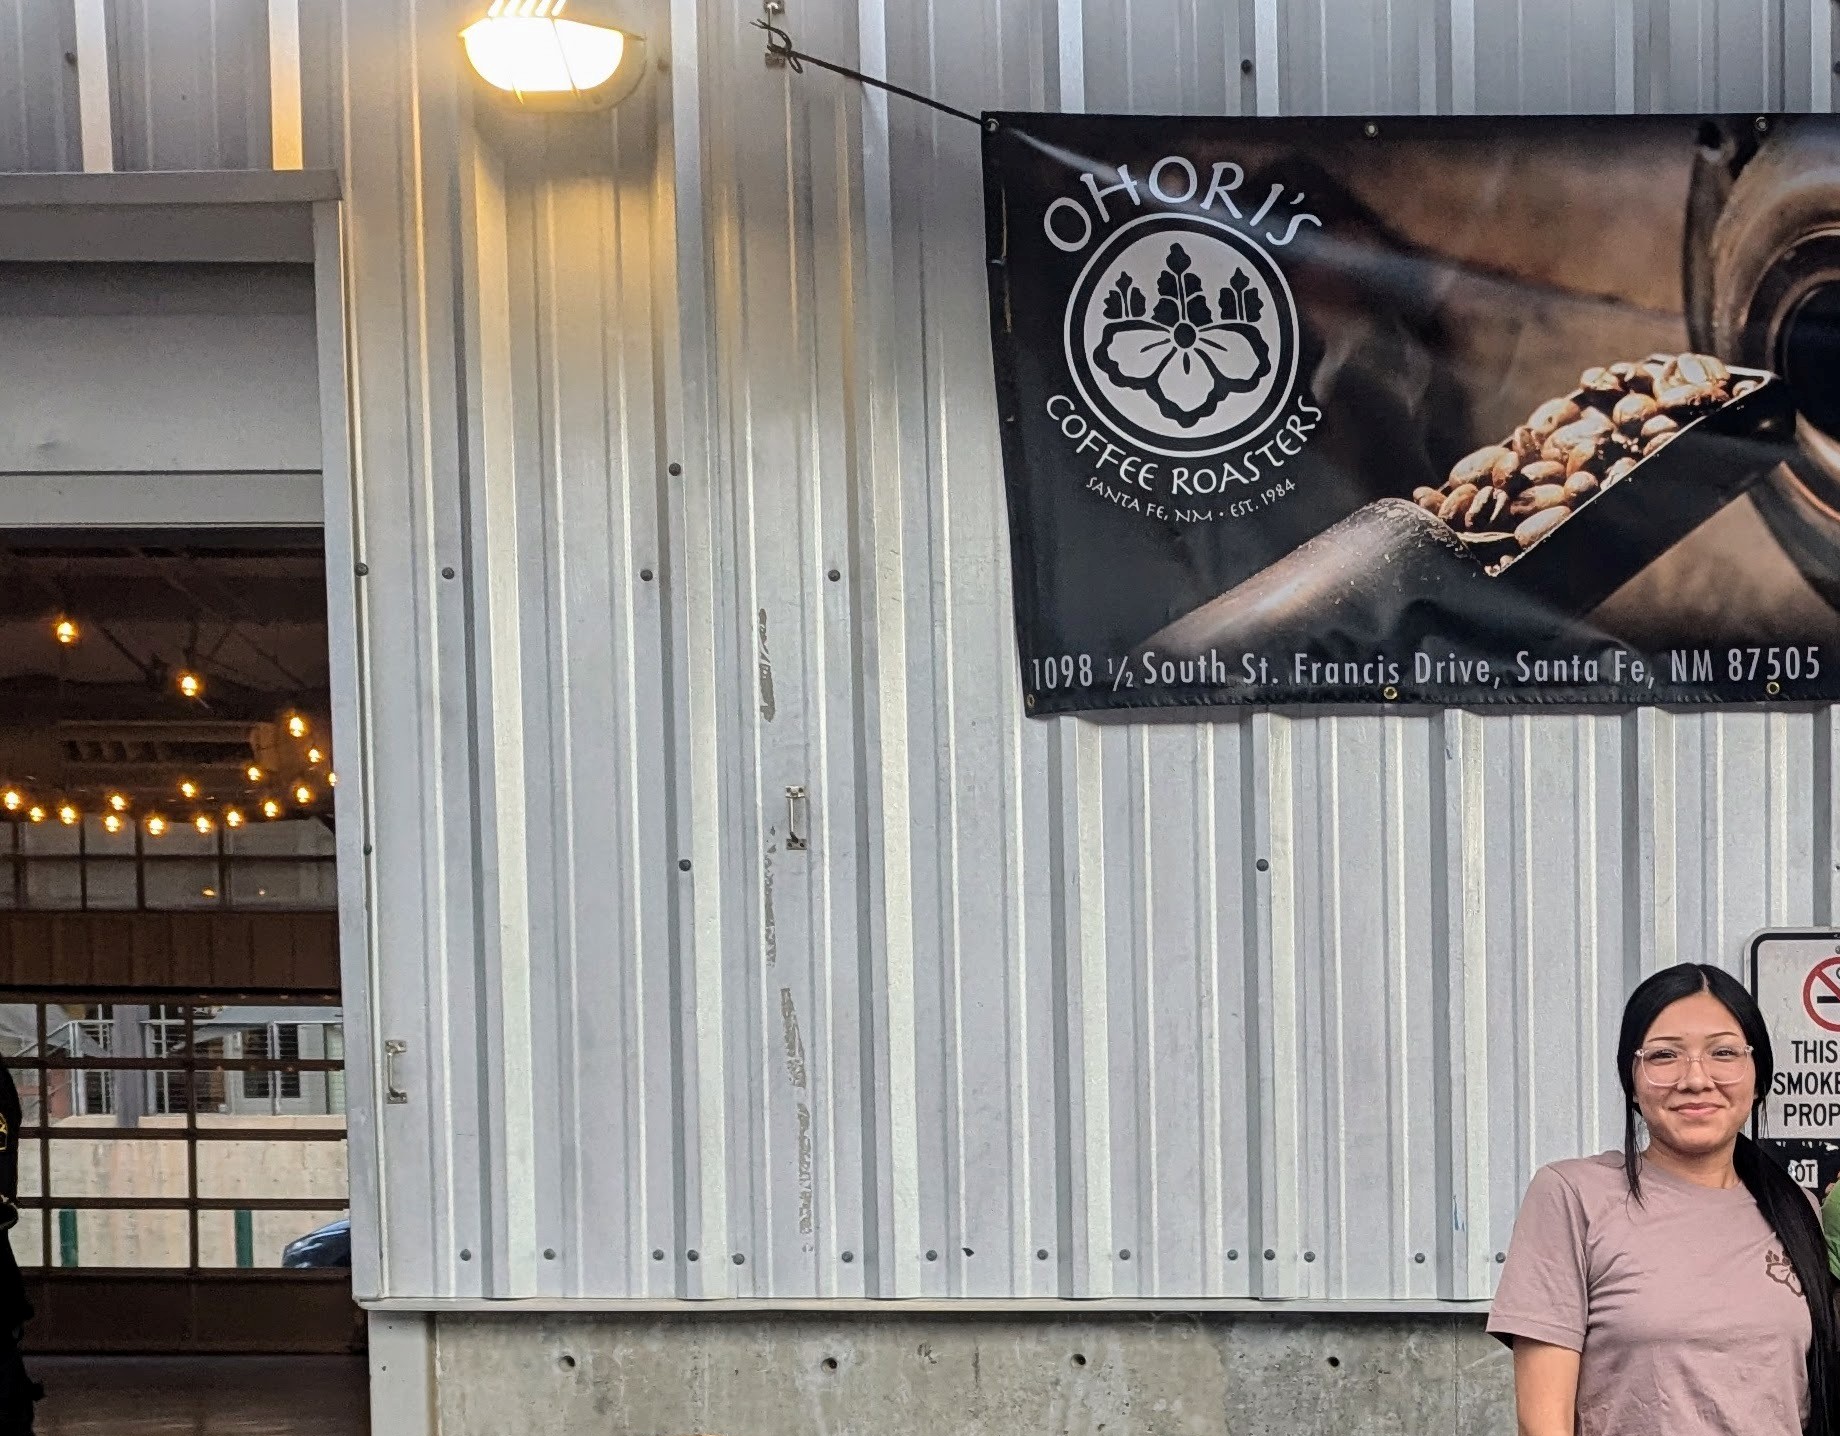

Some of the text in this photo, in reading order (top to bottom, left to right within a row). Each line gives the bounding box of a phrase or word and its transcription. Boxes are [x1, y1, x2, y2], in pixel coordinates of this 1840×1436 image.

[1044, 156, 1321, 252] OHORI'S
[1046, 395, 1322, 495] COFFEE ROASTERS
[1086, 476, 1296, 522] SANTA FE, NM EST. 1984
[1033, 654, 1093, 690] 1098
[1143, 651, 1226, 685] South
[1242, 652, 1278, 685] St.
[1294, 652, 1399, 685] Francis
[1414, 652, 1500, 689] Drive,
[1516, 650, 1599, 683] Santa
[1613, 650, 1654, 689] Fe,
[1670, 649, 1713, 682] NM
[1727, 646, 1820, 681] 87505
[1791, 1040, 1838, 1064] THIS
